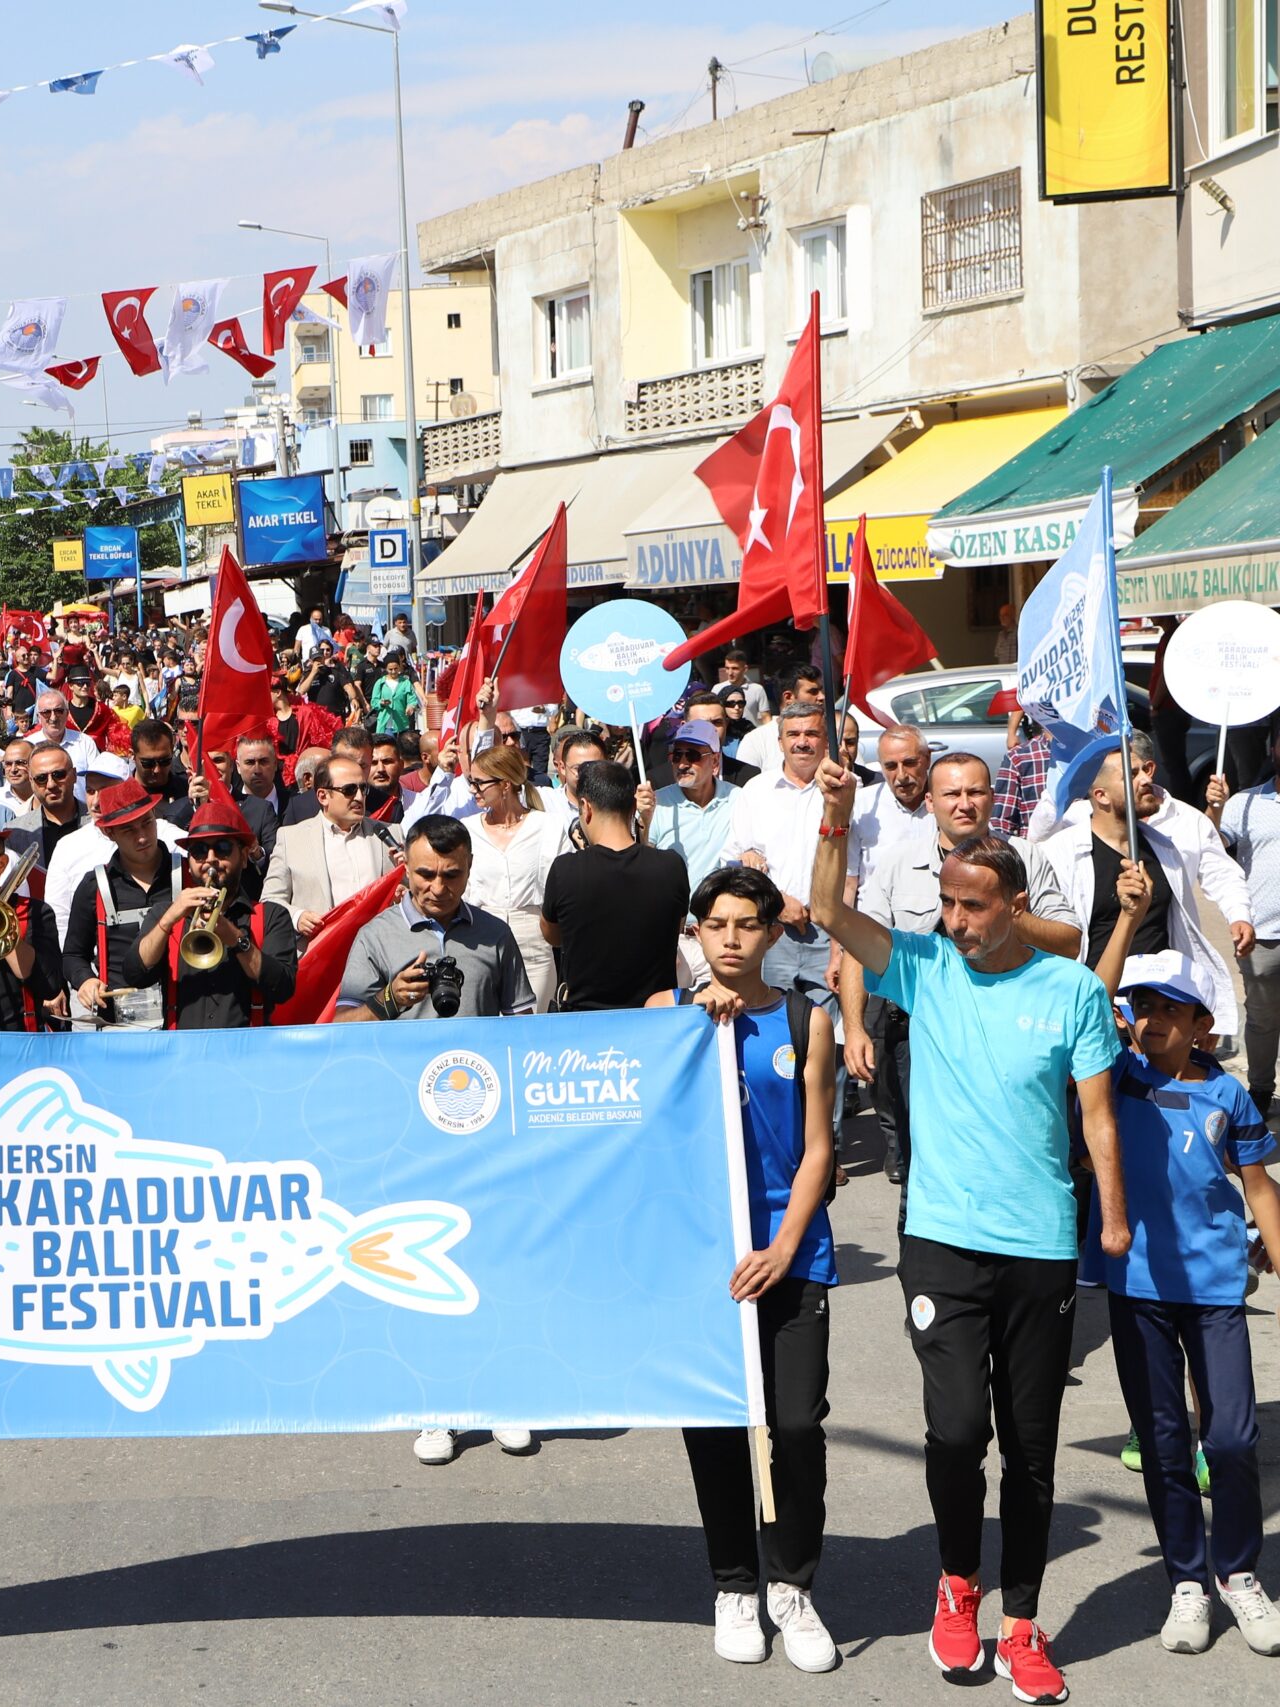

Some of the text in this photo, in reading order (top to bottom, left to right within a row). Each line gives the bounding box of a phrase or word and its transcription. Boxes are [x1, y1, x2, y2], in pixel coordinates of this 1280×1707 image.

[1115, 0, 1145, 85] REST
[196, 489, 220, 499] AKAR
[196, 500, 222, 510] TEKEL
[248, 511, 318, 529] AKAR TEKEL
[380, 538, 397, 559] D
[950, 518, 1084, 560] ÖZEN KASA
[1152, 570, 1198, 601] YILMAZ
[610, 641, 654, 654] KARADUVAR
[616, 651, 638, 660] BALIK
[558, 1046, 642, 1079] Mustafa
[1183, 1130, 1194, 1153] 7
[33, 1229, 181, 1277] BALIK
